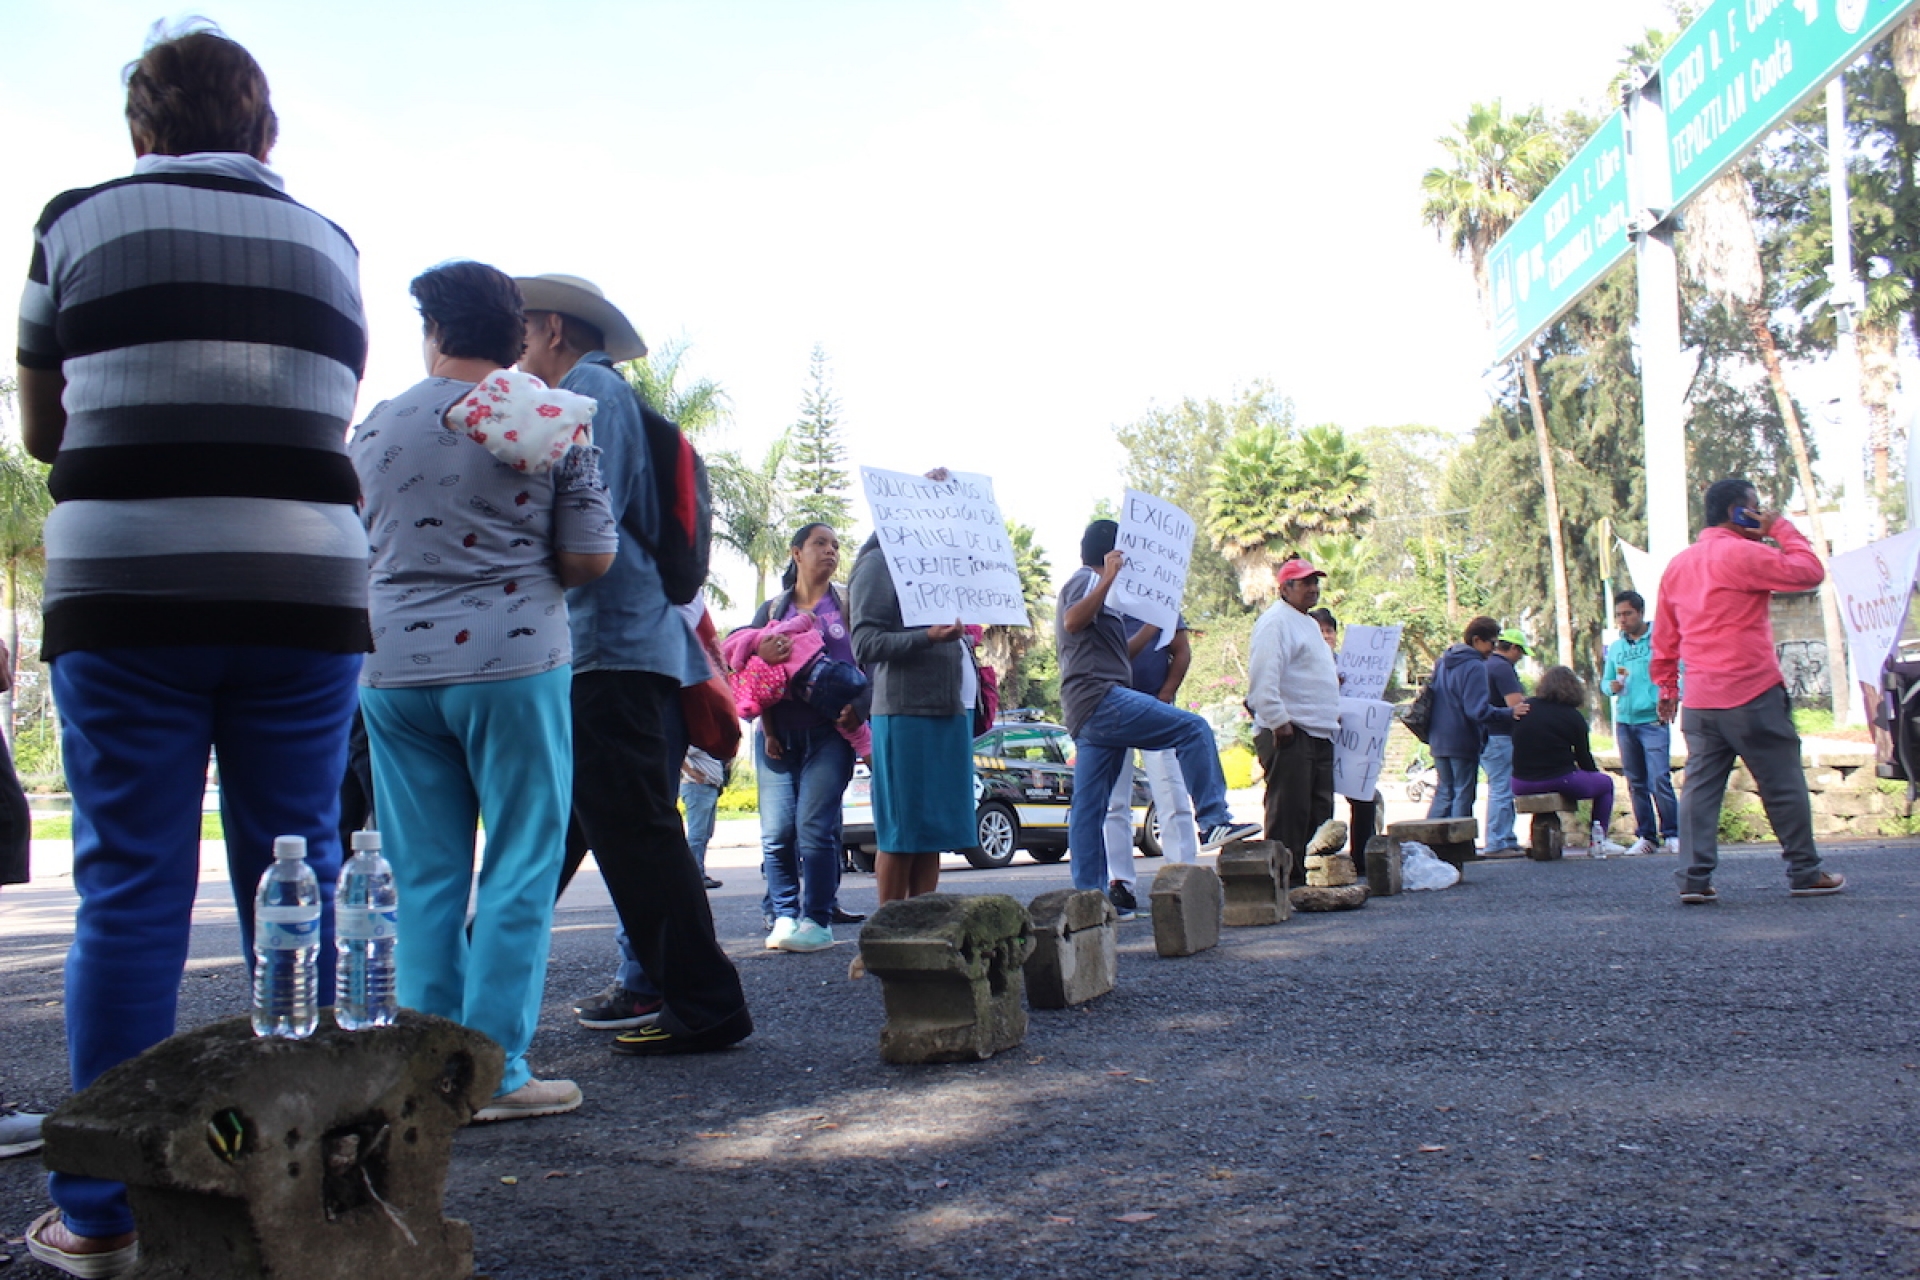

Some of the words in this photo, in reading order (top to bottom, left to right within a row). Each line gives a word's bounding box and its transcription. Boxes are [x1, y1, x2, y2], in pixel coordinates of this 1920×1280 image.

[1667, 44, 1705, 114] MEXICO
[1746, 0, 1784, 33] Cuo
[1672, 72, 1747, 174] TEPOZTLAN
[1751, 37, 1793, 103] Cuota
[868, 473, 981, 500] SOLICITAMOS
[980, 508, 999, 526] DE
[1130, 498, 1193, 540] EXIGIM
[880, 524, 960, 550] DANIEL
[964, 530, 982, 550] DE
[893, 555, 966, 580] FUENTE
